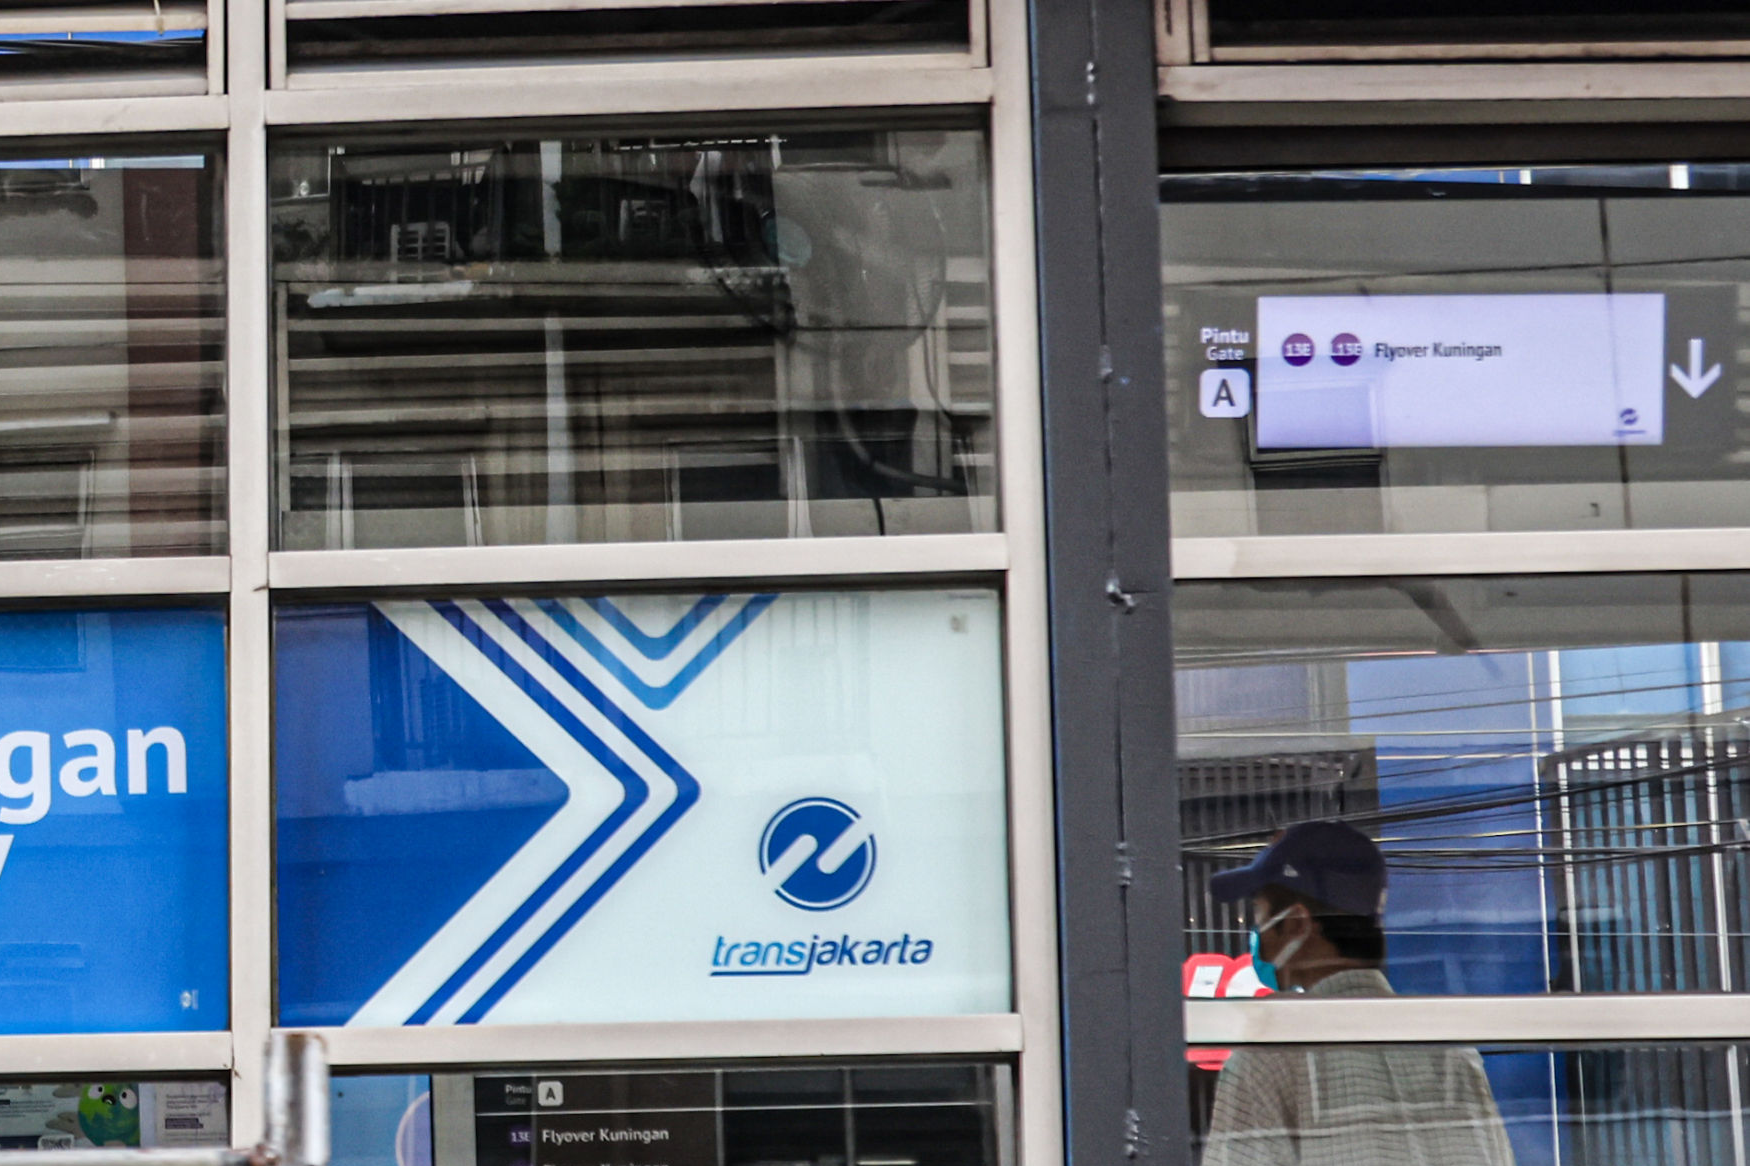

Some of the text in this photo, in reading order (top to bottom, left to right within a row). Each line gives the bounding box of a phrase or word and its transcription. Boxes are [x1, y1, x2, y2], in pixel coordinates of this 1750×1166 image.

[1201, 327, 1249, 344] Pintu
[1206, 346, 1245, 361] Gate
[1374, 342, 1428, 361] Flyover
[1433, 341, 1502, 361] Kuningan
[1212, 377, 1236, 408] A
[709, 933, 934, 976] transjakarta
[545, 1087, 557, 1101] A
[511, 1128, 670, 1145] 13E Flyover Kuningan
